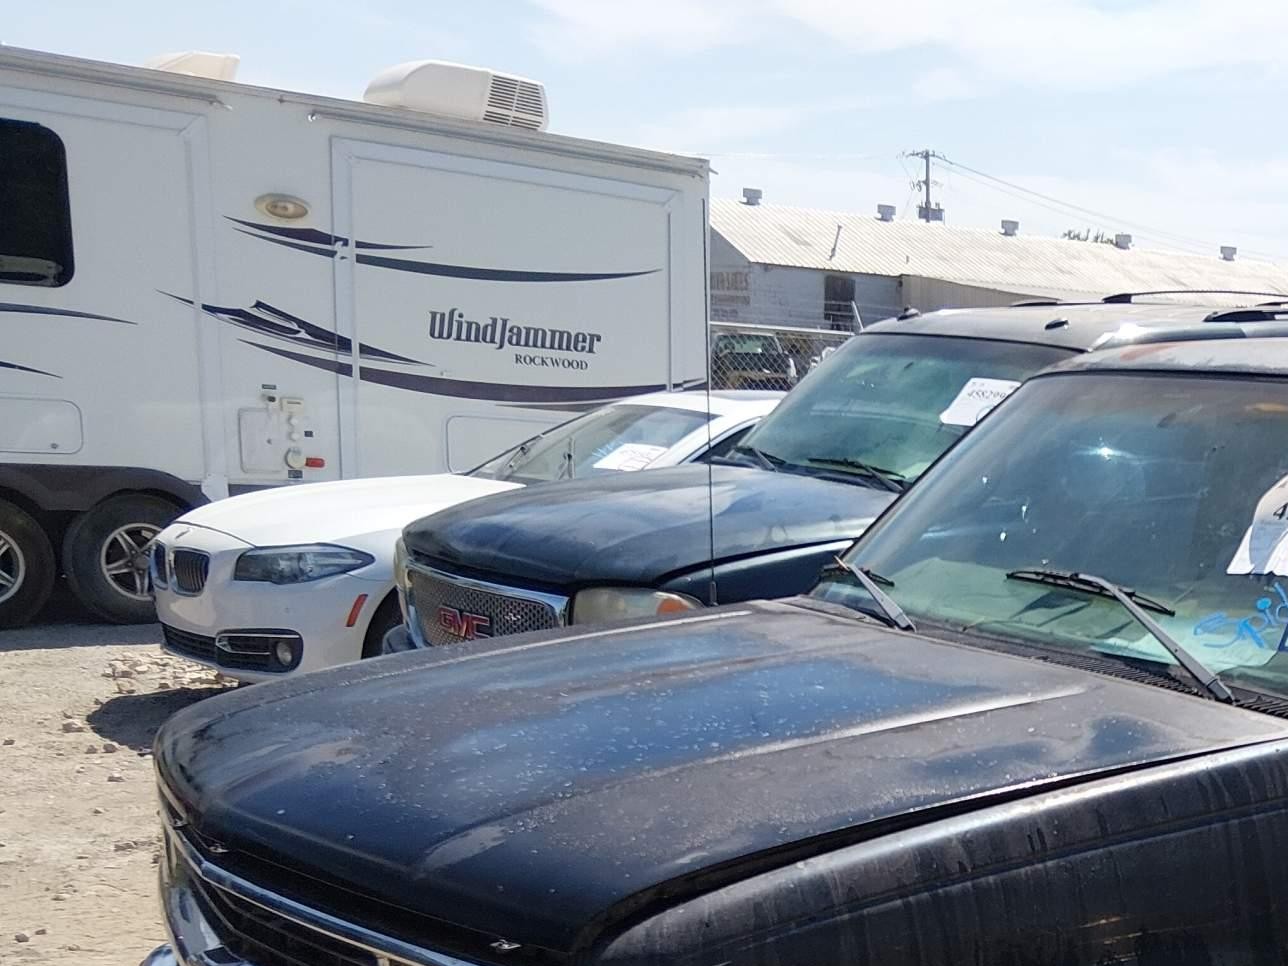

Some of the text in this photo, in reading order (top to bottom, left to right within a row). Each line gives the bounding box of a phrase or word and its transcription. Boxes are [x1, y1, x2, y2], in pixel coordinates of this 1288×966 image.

[429, 307, 602, 355] WindJammer
[514, 353, 589, 371] ROCKWOOD
[437, 605, 490, 640] GMC
